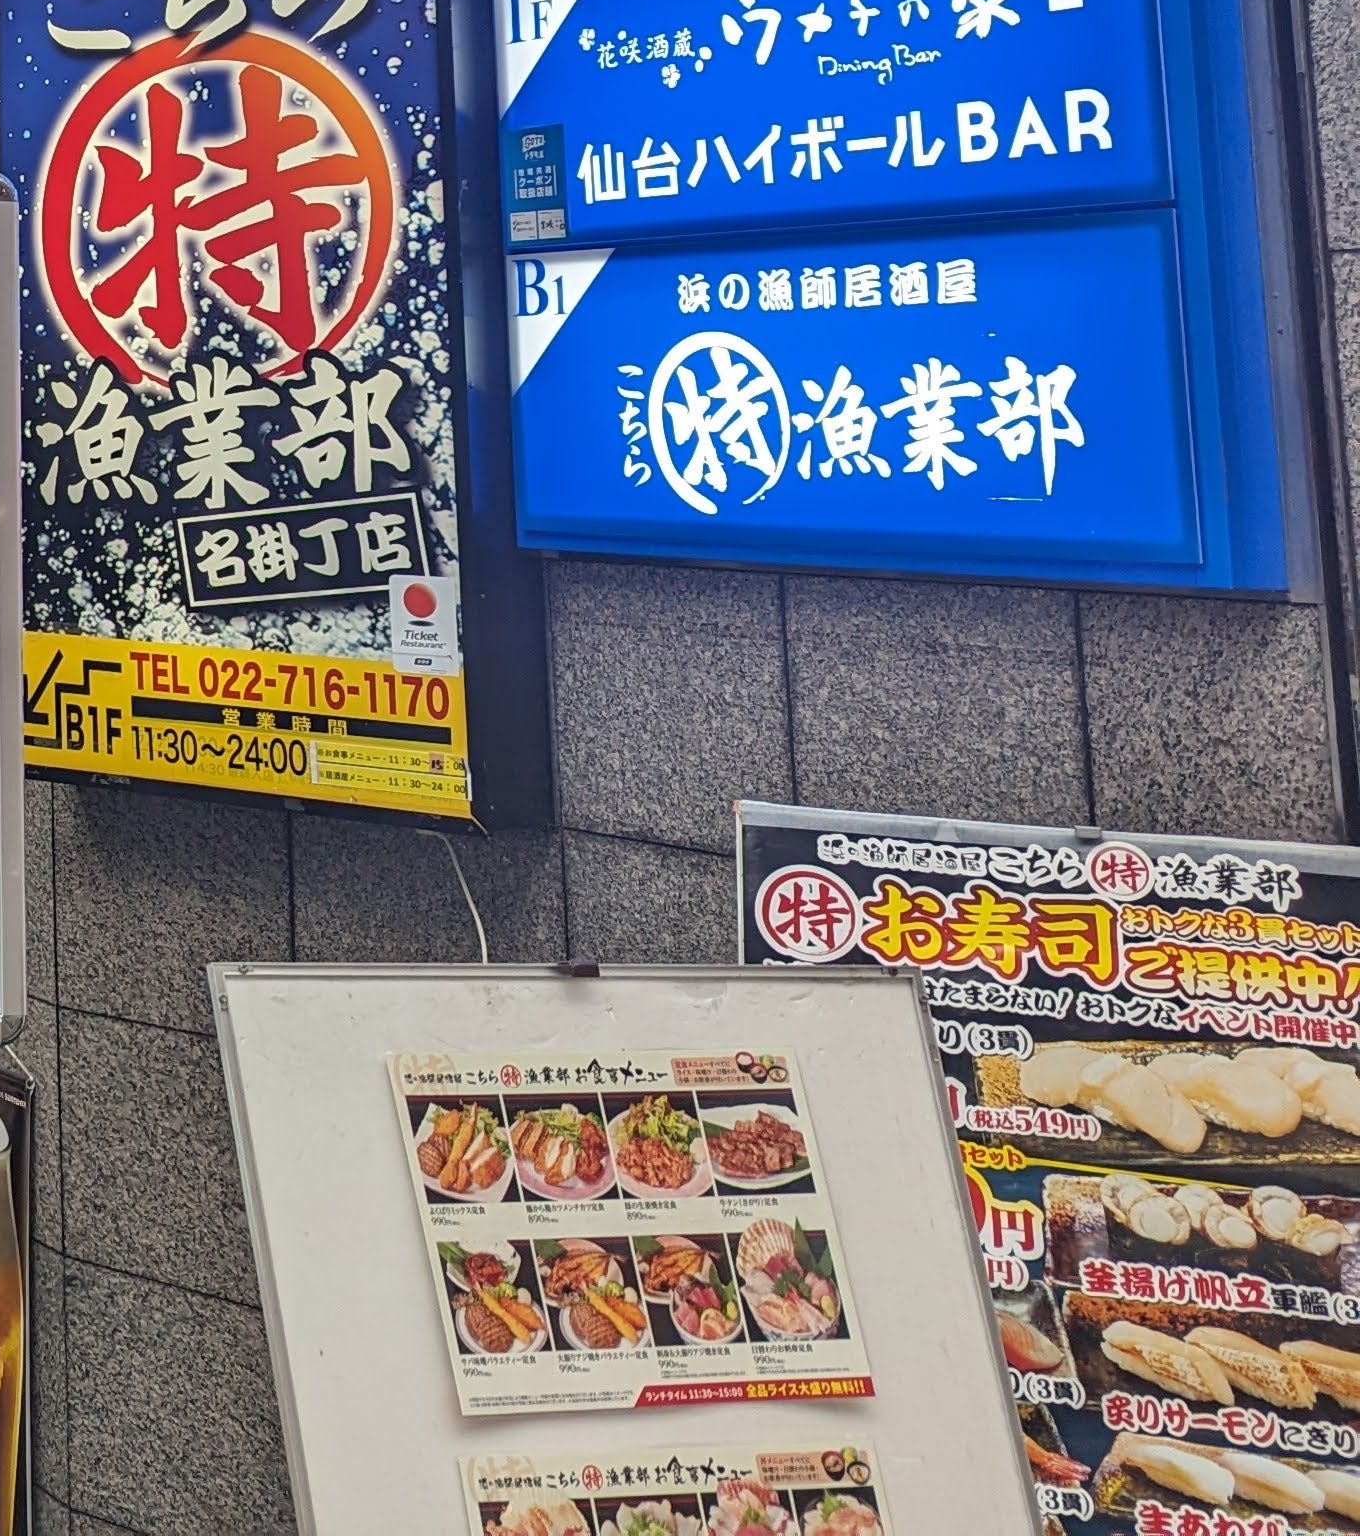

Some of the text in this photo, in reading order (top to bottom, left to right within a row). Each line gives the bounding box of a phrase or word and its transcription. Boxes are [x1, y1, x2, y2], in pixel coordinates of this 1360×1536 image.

[597, 30, 696, 69] 花咲酒蔵
[819, 44, 942, 84] Dining Bar
[577, 88, 1113, 205] 仙台ハイボールBAR
[70, 54, 375, 357] 特
[513, 259, 566, 317] B1
[677, 258, 978, 314] 浜の漁師居酒屋
[36, 357, 410, 507] 漁業部
[616, 340, 1085, 504] こちら 特 漁業部
[194, 512, 412, 588] 名掛丁店
[404, 629, 438, 641] Ticket
[130, 651, 450, 720] TEL 022-716-1170
[66, 703, 122, 755] B1F
[222, 708, 347, 736] 営業時間
[989, 846, 1082, 889] こちら
[1160, 856, 1298, 904] 漁業部
[867, 882, 1116, 982] お寿司
[524, 1067, 571, 1085] 漁業部
[574, 1059, 669, 1084] お食事メニュー
[606, 1468, 651, 1487] 漁業部
